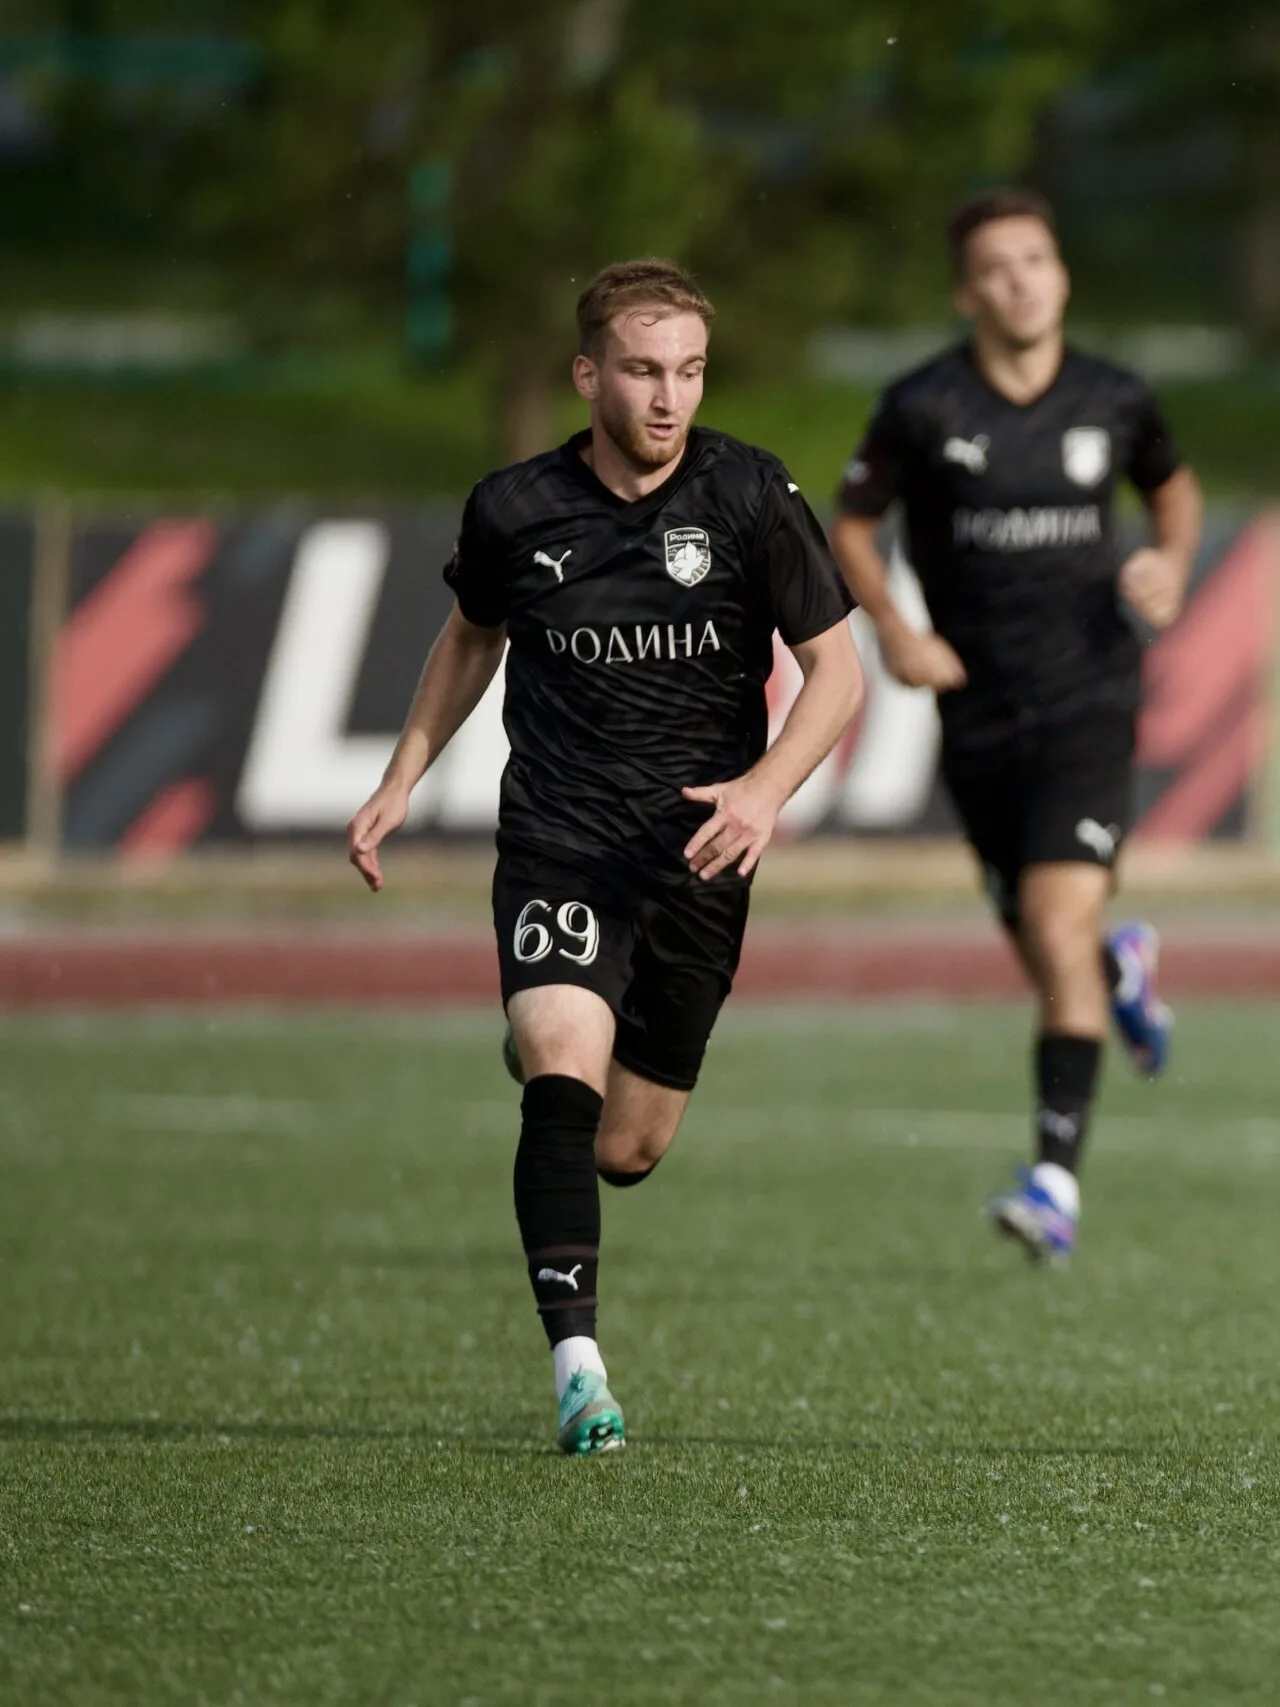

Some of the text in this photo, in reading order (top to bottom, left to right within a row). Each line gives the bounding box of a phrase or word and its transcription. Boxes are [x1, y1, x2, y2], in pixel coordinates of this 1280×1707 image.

[669, 533, 705, 541] Родина
[546, 619, 721, 664] РОДИНА
[513, 899, 599, 966] 69
